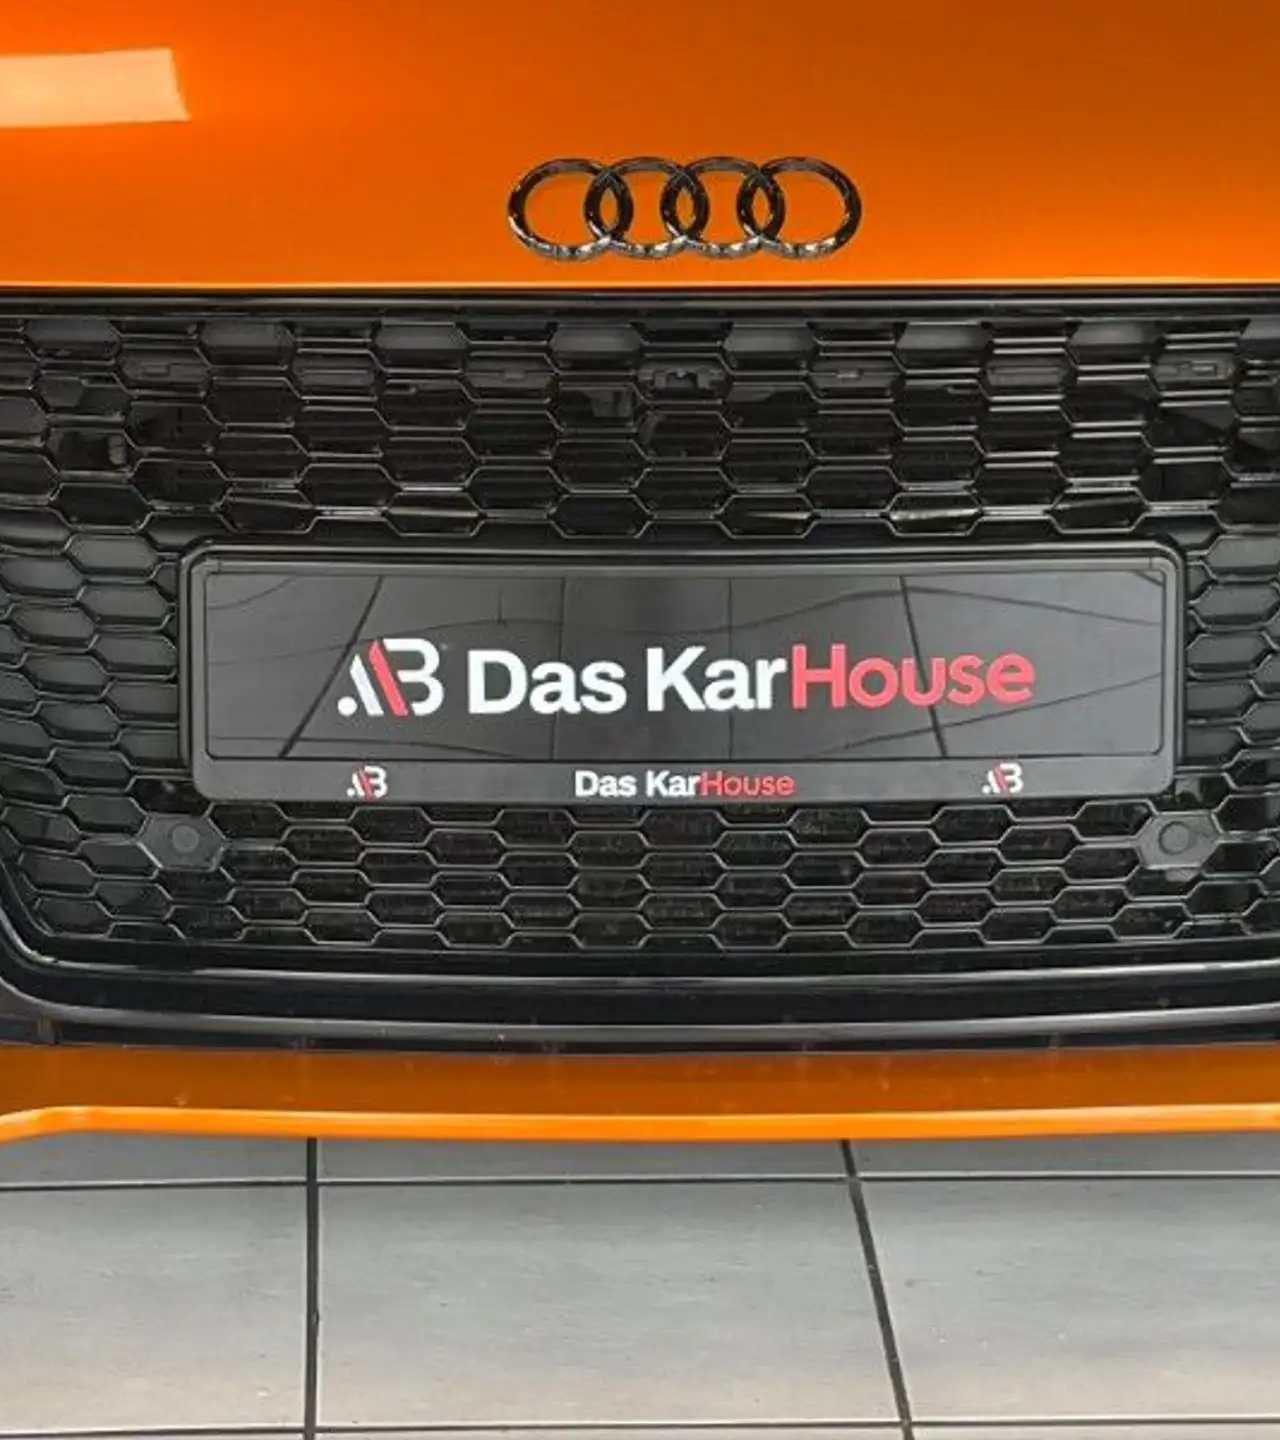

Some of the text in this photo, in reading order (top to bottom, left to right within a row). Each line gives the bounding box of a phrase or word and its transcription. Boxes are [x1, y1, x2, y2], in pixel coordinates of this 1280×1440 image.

[467, 649, 627, 715] Das
[646, 643, 1038, 712] KarHouse
[574, 769, 796, 799] Das KarHouse
